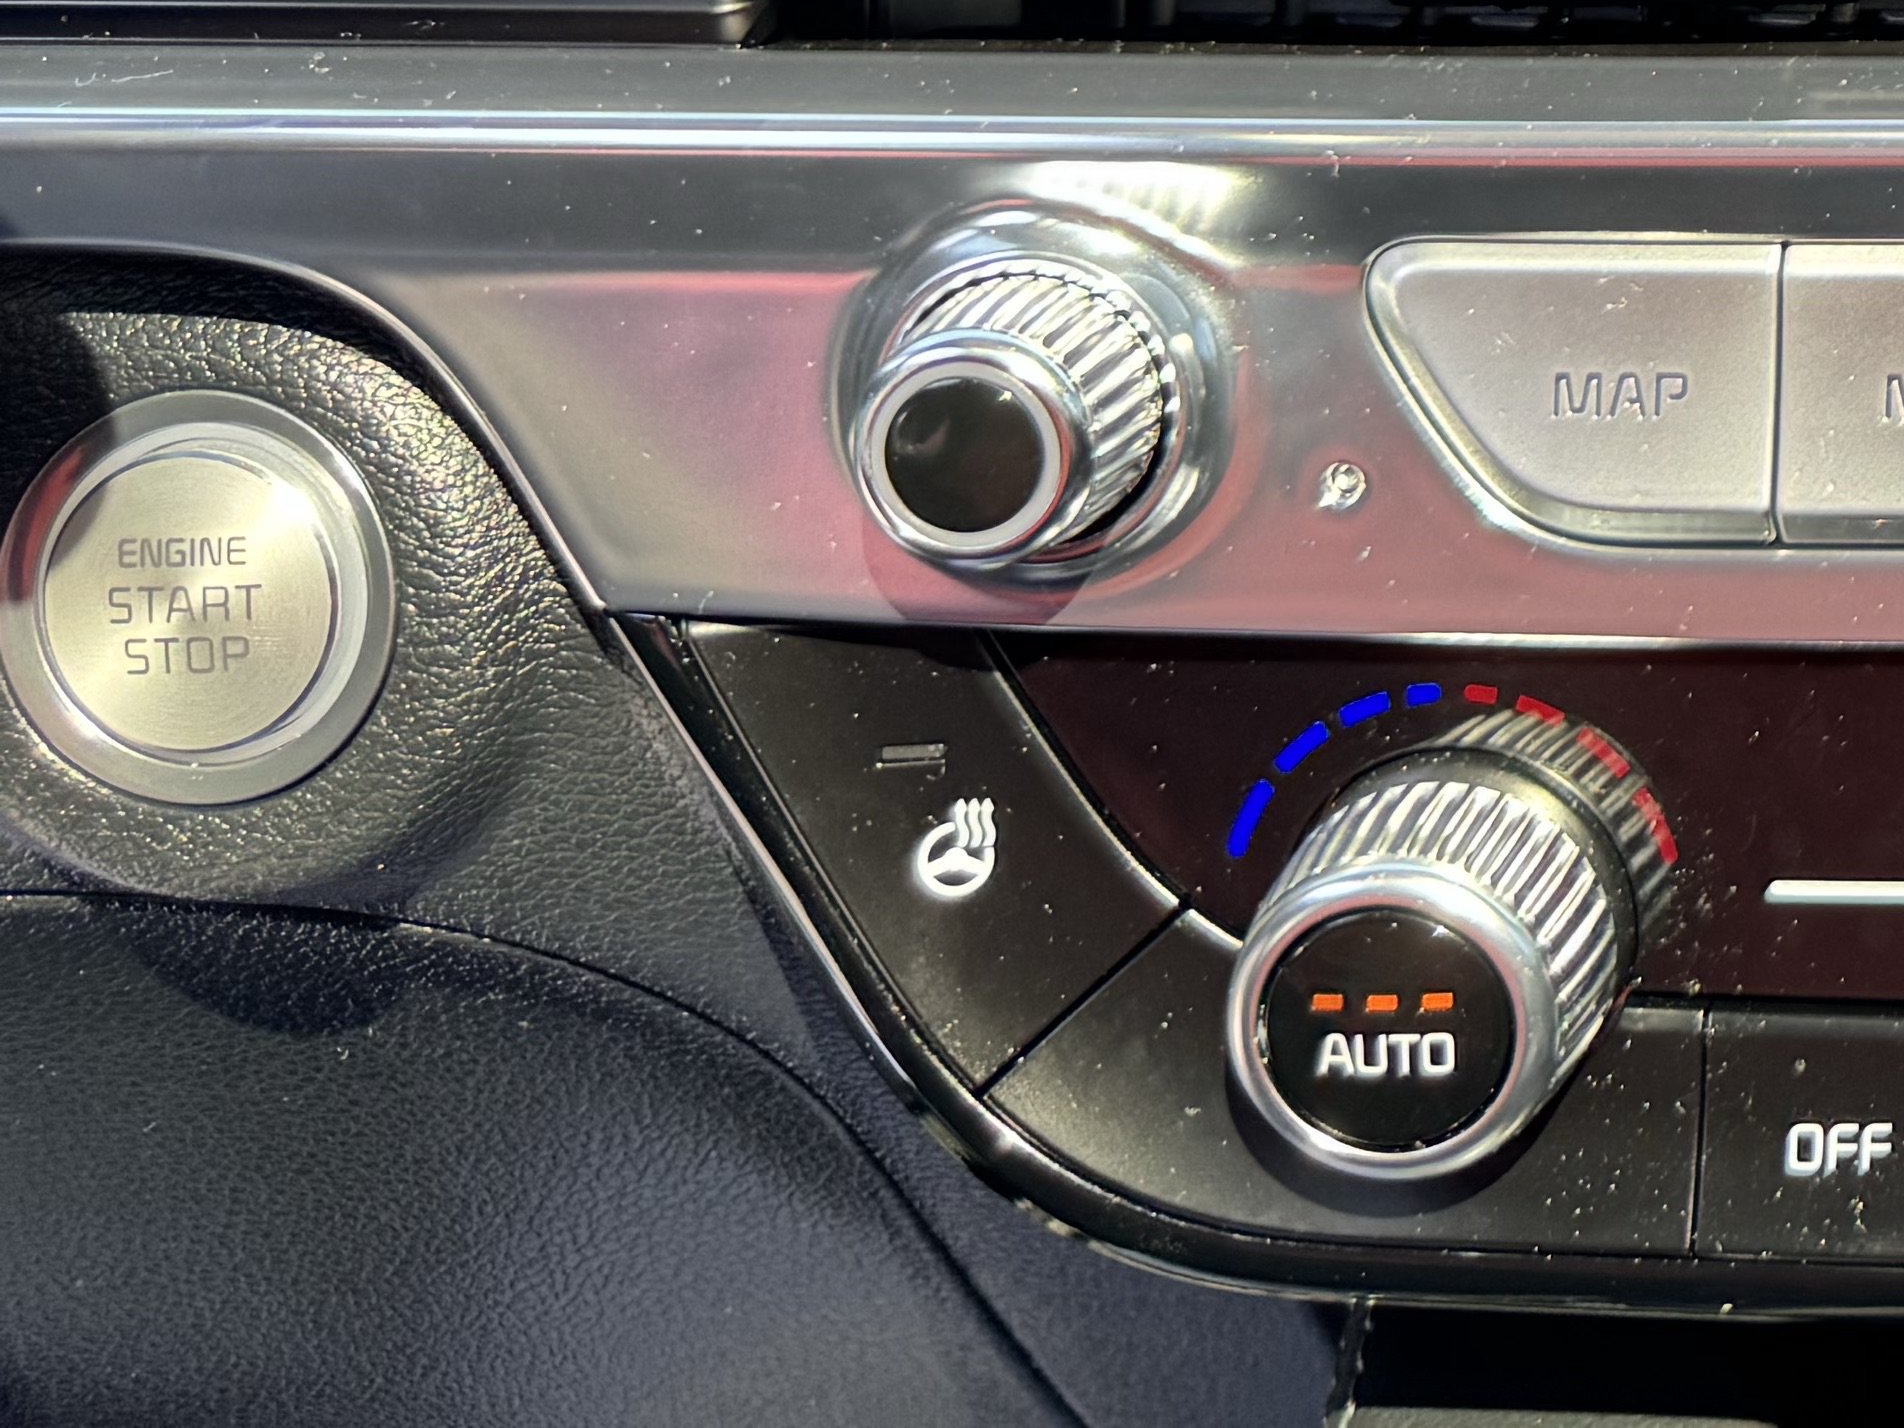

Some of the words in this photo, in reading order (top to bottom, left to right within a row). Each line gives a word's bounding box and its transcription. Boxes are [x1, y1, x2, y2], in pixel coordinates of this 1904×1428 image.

[1550, 370, 1690, 418] MAP
[117, 536, 247, 568] ENGINE
[108, 584, 262, 624] START
[124, 636, 250, 675] STOP
[1317, 1032, 1455, 1077] AUTO
[1785, 1123, 1892, 1177] OFF
